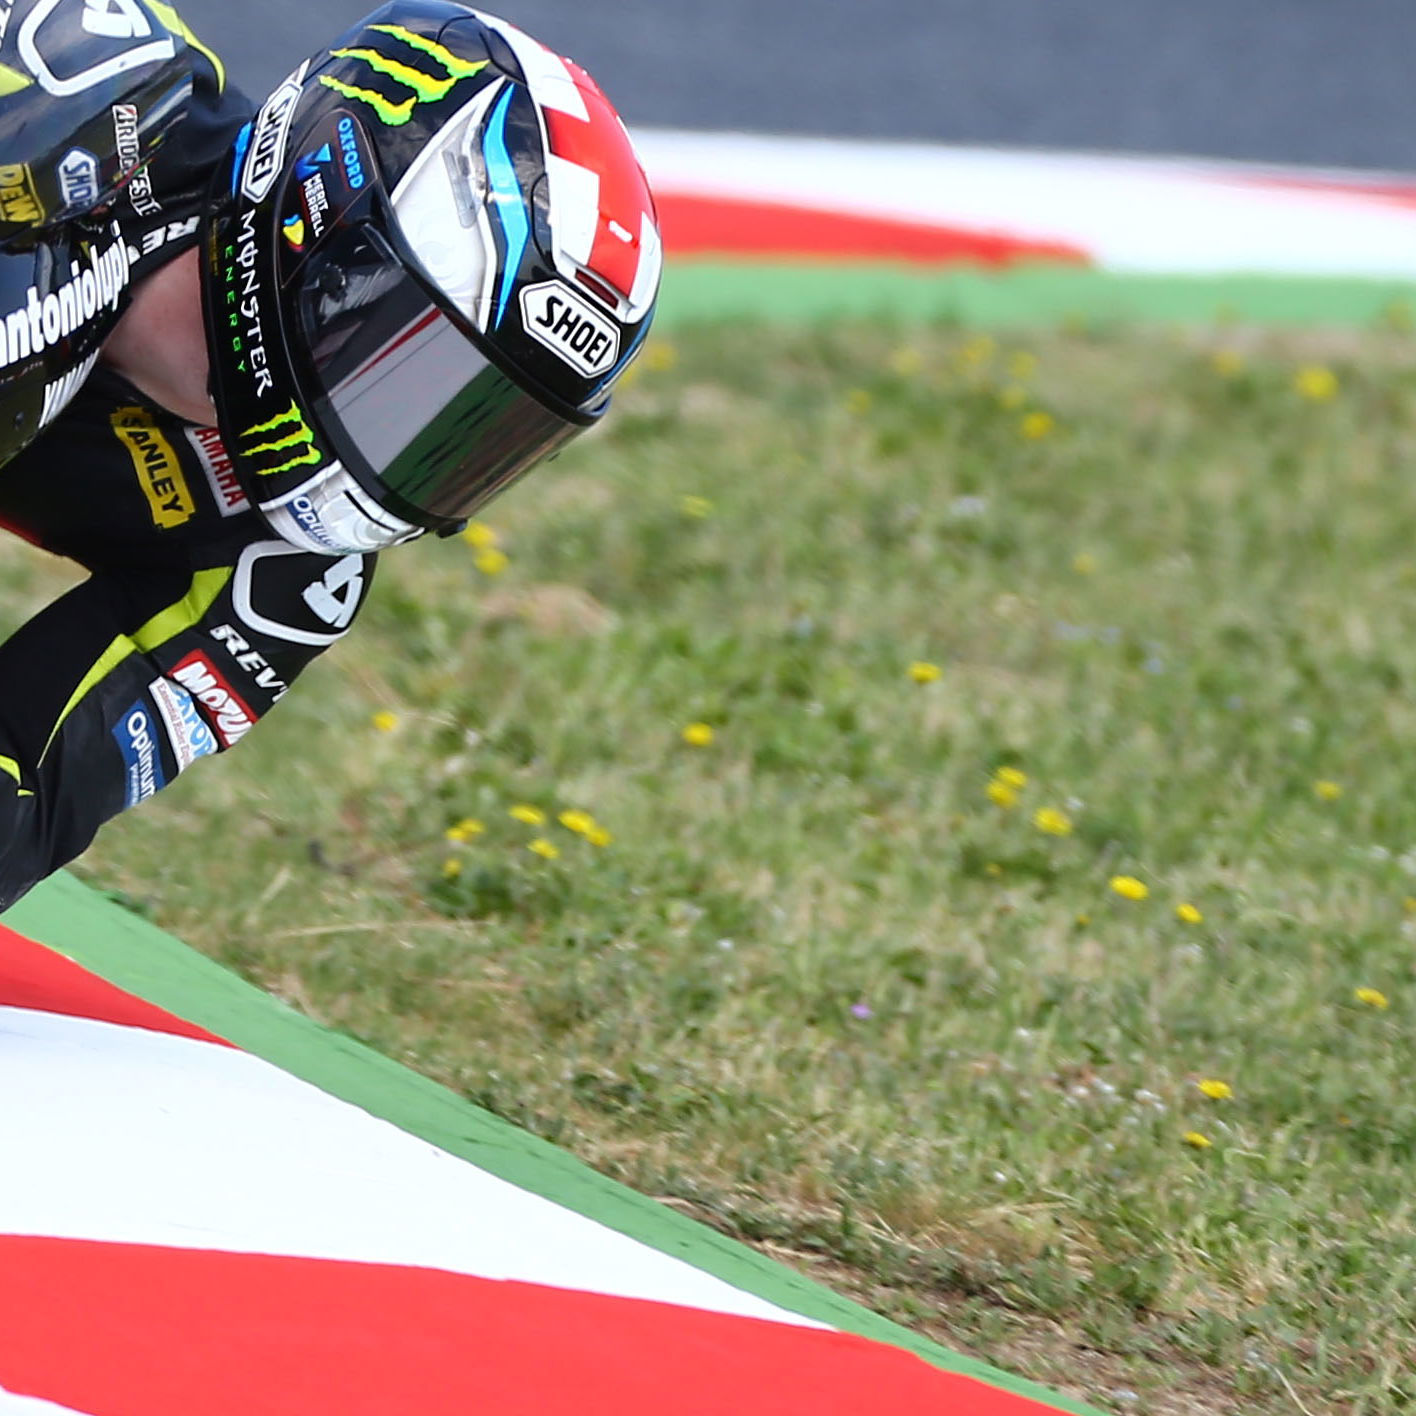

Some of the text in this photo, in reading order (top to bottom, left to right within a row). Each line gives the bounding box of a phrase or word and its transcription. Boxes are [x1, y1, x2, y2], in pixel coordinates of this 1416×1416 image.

[338, 117, 364, 189] OXFORD
[310, 173, 328, 211] MERIT
[224, 245, 246, 375] ENERGY
[237, 208, 274, 397] MONSTER
[535, 295, 611, 368] SHOEI
[194, 427, 248, 507] AMAHA
